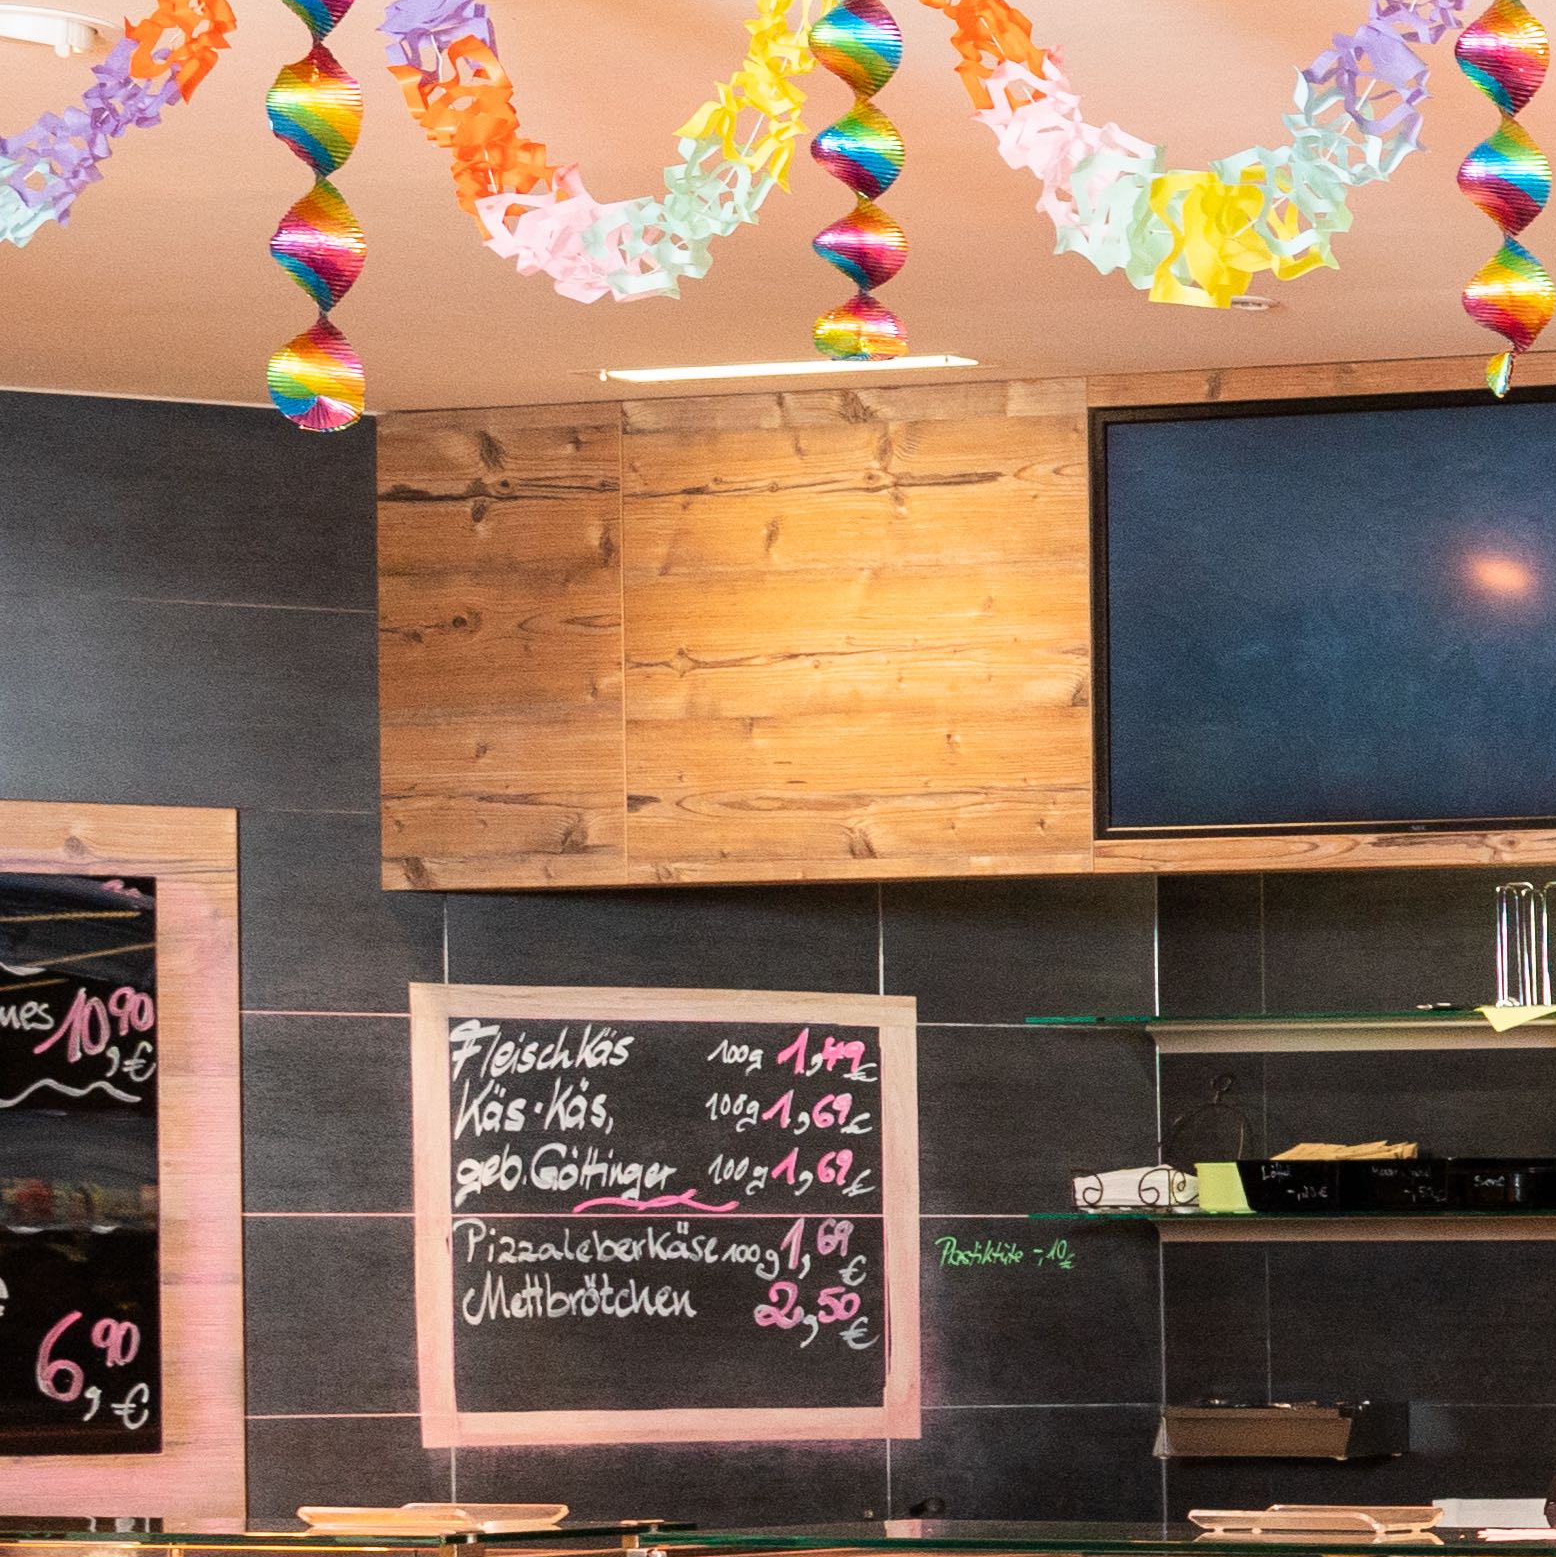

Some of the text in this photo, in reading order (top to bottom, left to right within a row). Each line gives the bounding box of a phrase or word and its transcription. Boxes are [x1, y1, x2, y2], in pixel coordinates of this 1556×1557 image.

[707, 1039, 763, 1076] 100g
[706, 1092, 760, 1132] 100g
[462, 1270, 697, 1325] Mettbrötchen
